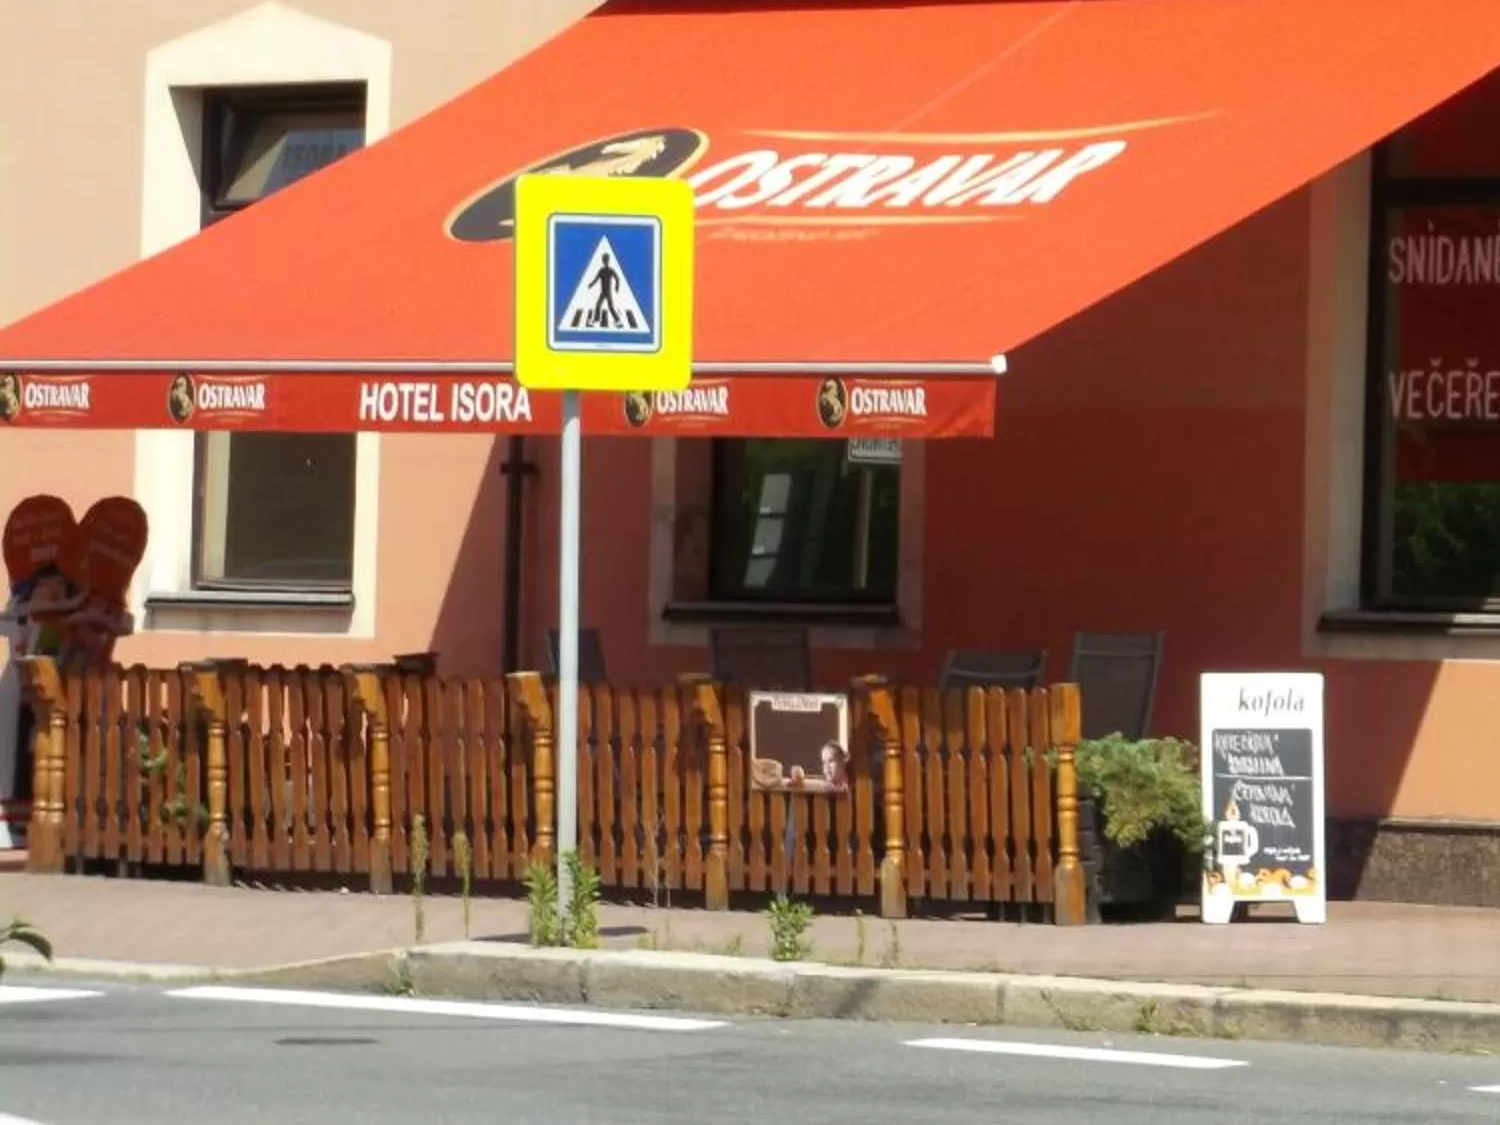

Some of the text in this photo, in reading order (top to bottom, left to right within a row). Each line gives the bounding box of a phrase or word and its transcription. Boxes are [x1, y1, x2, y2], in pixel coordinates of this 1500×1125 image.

[693, 140, 1127, 209] OSTRAVAR
[25, 382, 91, 409] OSTRAVAR
[199, 383, 265, 411] OSTRAVAR
[359, 383, 532, 423] HOTEL ISORA
[656, 388, 729, 414] OSTRAVAR
[851, 387, 928, 416] OSTRAVAR
[1238, 687, 1305, 716] kofola
